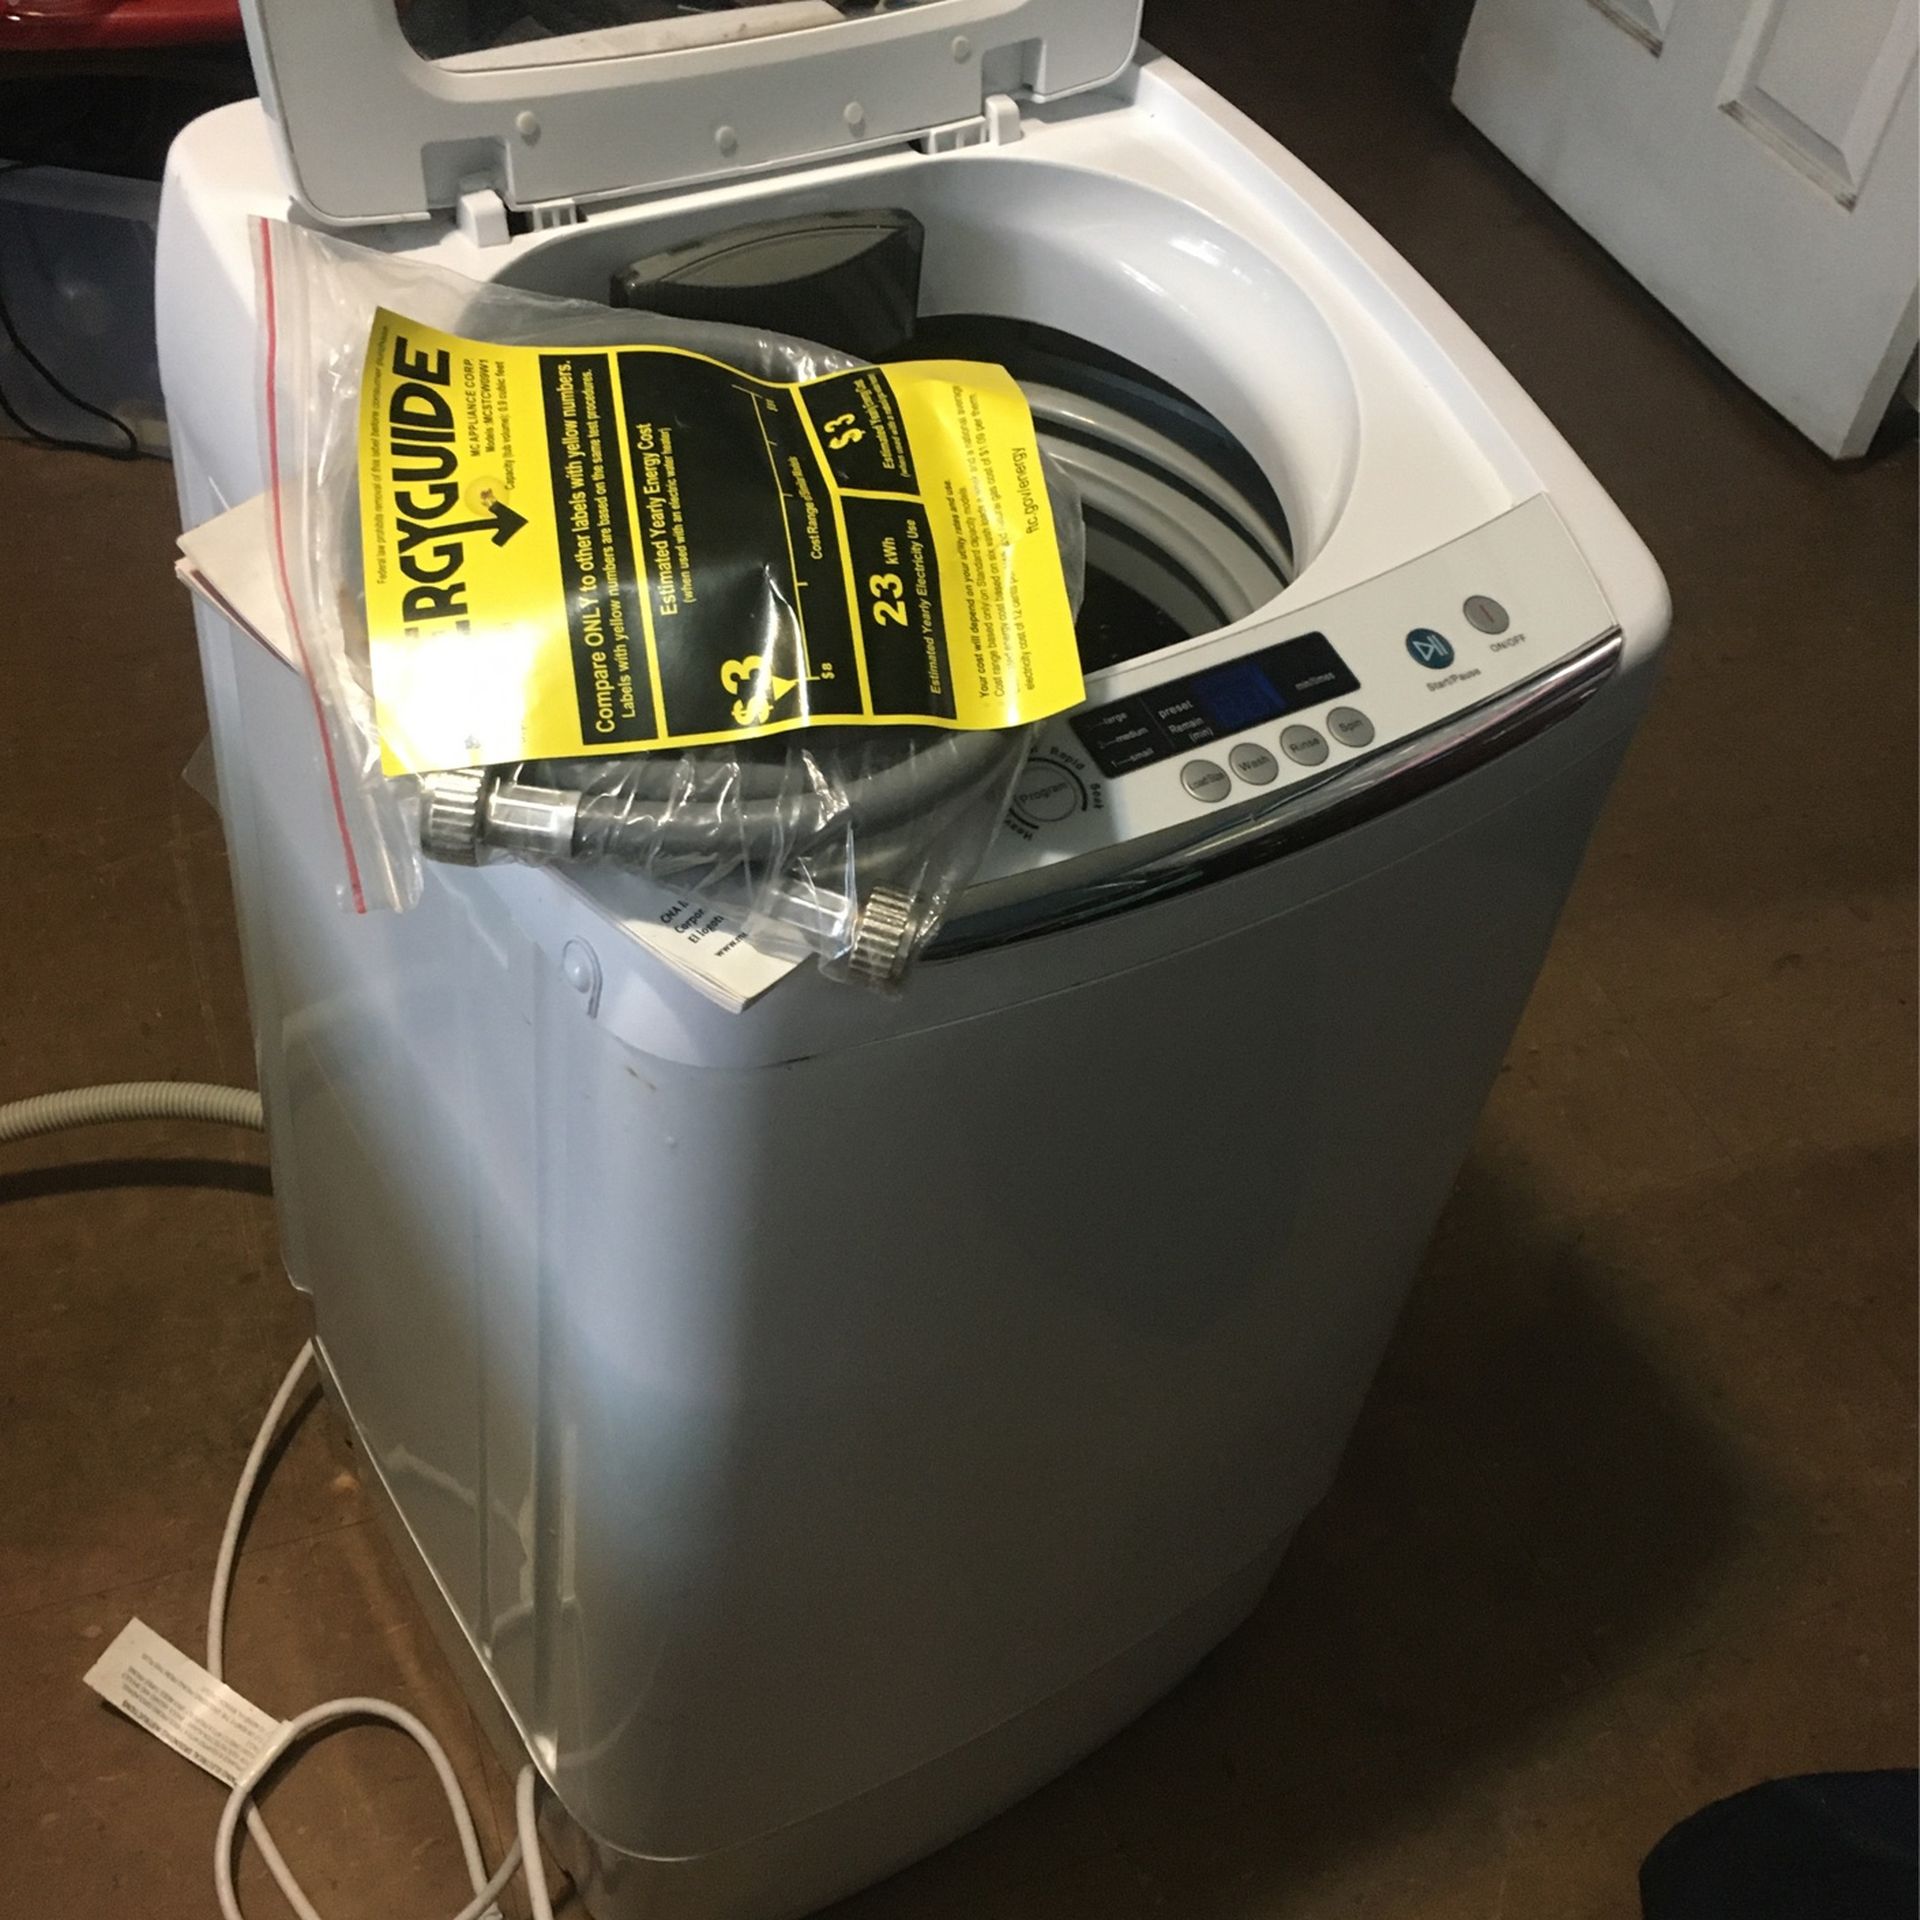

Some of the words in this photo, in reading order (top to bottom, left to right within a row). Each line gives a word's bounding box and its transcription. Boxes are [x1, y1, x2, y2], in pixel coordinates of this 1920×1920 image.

[495, 362, 505, 377] feet
[496, 379, 507, 399] cubic
[557, 361, 576, 417] numbers.
[582, 369, 600, 419] procedures.
[371, 412, 381, 437] before
[466, 391, 479, 442] APPLIANCE
[975, 419, 986, 431] per
[562, 420, 585, 458] yellow
[587, 421, 599, 437] test
[636, 423, 654, 450] Cost
[658, 428, 672, 454] heater)
[824, 413, 866, 449] $3
[958, 417, 972, 449] national
[371, 439, 381, 456] label
[470, 444, 480, 456] MC
[502, 444, 512, 457] (tub
[591, 439, 602, 463] same
[371, 459, 381, 472] this
[504, 460, 515, 490] Capacity
[564, 461, 584, 489] with
[591, 465, 605, 480] the
[641, 453, 661, 494] Energy
[663, 456, 676, 477] water
[966, 457, 977, 472] and
[984, 467, 995, 484] cost
[372, 484, 383, 512] removal
[594, 482, 607, 495] on
[666, 479, 680, 509] electric
[991, 486, 1001, 501] gas
[1011, 448, 1039, 534] ftc.gov/energy
[568, 491, 589, 532] labels
[594, 497, 610, 526] based
[946, 497, 957, 512] and
[374, 514, 386, 543] prohibits
[646, 497, 666, 538] Yearly
[672, 512, 682, 522] an
[805, 502, 818, 534] Range
[906, 519, 919, 539] Use
[952, 514, 963, 535] rates
[602, 528, 613, 543] are
[672, 524, 686, 543] with
[966, 517, 980, 547] capacity
[982, 528, 994, 546] wash
[376, 545, 385, 557] law
[575, 534, 594, 571] other
[675, 546, 689, 568] used
[810, 535, 823, 559] Cost
[882, 537, 899, 564] kWh
[956, 537, 967, 560] utility
[986, 549, 996, 560] six
[377, 558, 387, 584] Federal
[602, 546, 620, 596] numbers
[652, 540, 678, 615] Estimated
[910, 541, 928, 596] Electricity
[960, 562, 974, 583] your
[972, 549, 987, 587] Standard
[989, 563, 998, 574] on
[579, 575, 597, 591] to
[681, 571, 696, 603] (when
[966, 585, 974, 596] on
[990, 576, 1003, 602] based
[869, 573, 908, 626] 23
[980, 590, 989, 601] on
[1009, 586, 1020, 607] cents
[578, 596, 604, 646] ONLY
[610, 600, 629, 641] yellow
[918, 599, 933, 634] Yearly
[966, 599, 980, 633] depend
[980, 601, 992, 620] only
[996, 604, 1007, 621] cost
[971, 635, 982, 651] will
[983, 623, 995, 648] based
[1002, 624, 1013, 651] energy
[1017, 631, 1028, 650] cost
[1490, 634, 1526, 652] ON/OFF
[614, 644, 629, 671] with
[923, 636, 941, 694] Estimated
[975, 654, 986, 674] cost
[989, 650, 1002, 675] range
[1016, 651, 1035, 690] electricity
[1426, 668, 1482, 692] Start/Pause
[590, 652, 616, 733] Compare
[618, 675, 636, 718] Labels
[721, 655, 773, 725] $3
[979, 676, 990, 698] Your
[993, 677, 1005, 697] Cost
[1158, 700, 1194, 719] preset
[1168, 717, 1204, 734] Remain
[1338, 719, 1363, 733] Spin
[1290, 737, 1320, 753] Rinse
[1050, 746, 1085, 770] Rapid
[1239, 755, 1270, 771] Wash
[1019, 782, 1068, 805] Program
